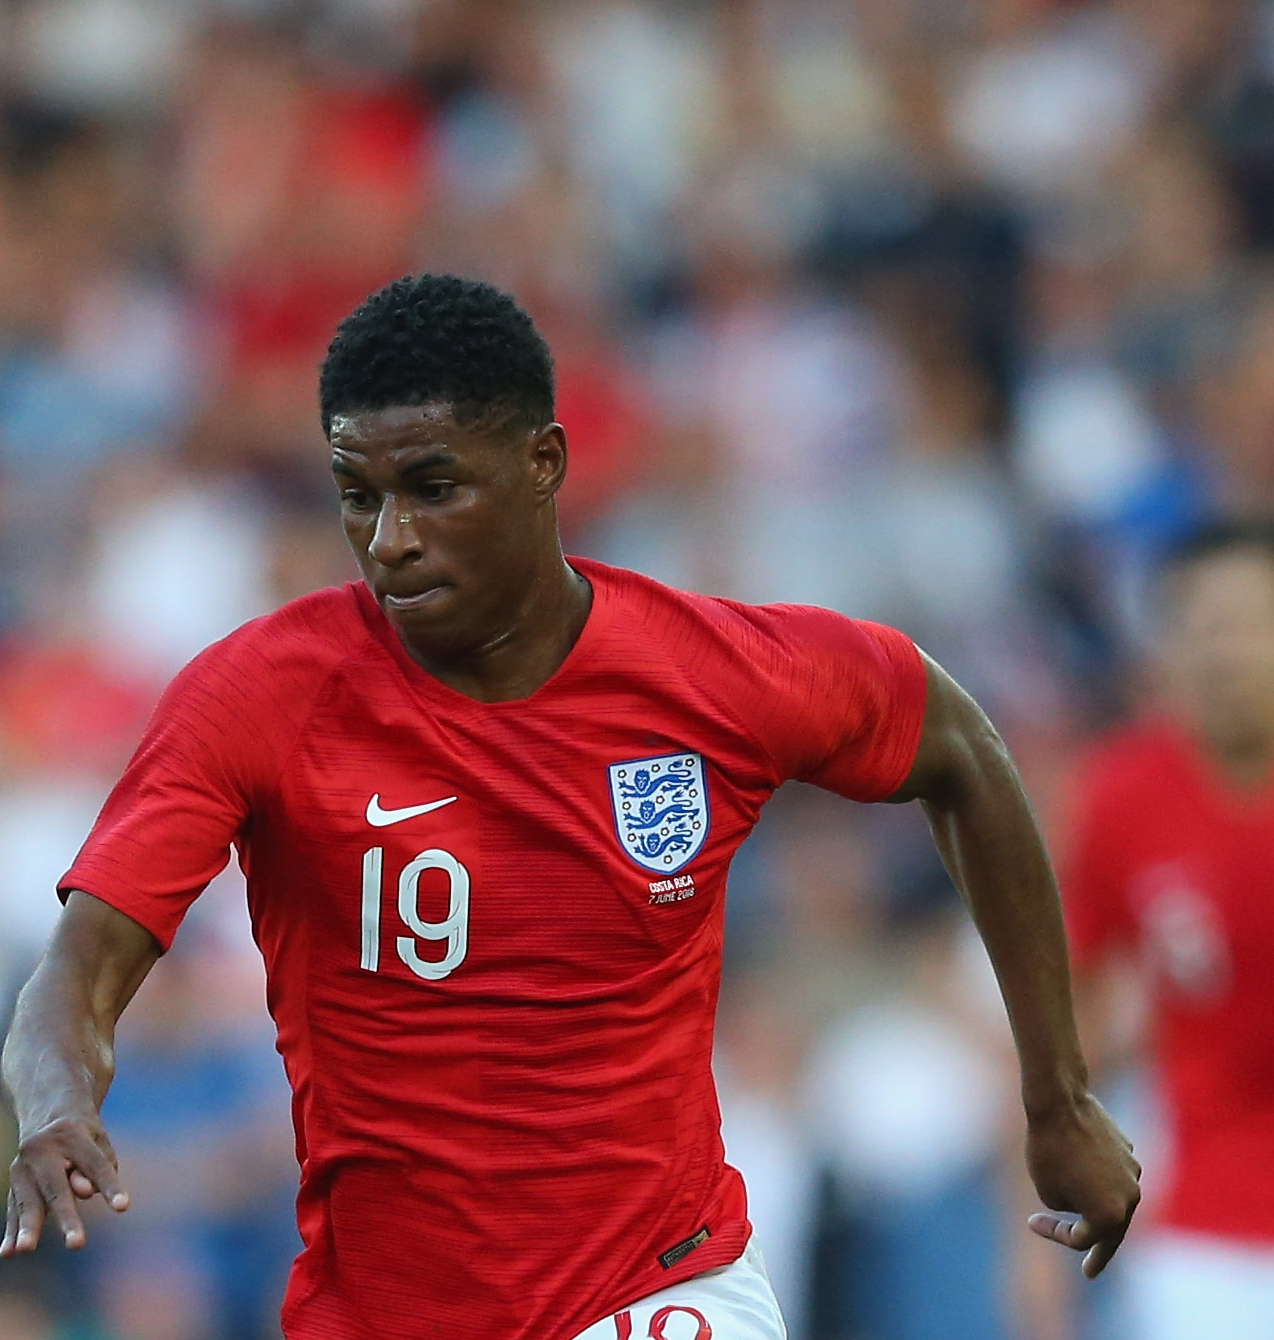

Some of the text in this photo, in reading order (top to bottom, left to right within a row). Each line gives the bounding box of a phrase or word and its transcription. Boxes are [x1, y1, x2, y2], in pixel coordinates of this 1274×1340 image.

[648, 875, 694, 893] COSTA RICA
[648, 894, 655, 904] 7
[655, 891, 676, 904] JUNE
[359, 845, 471, 981] 19
